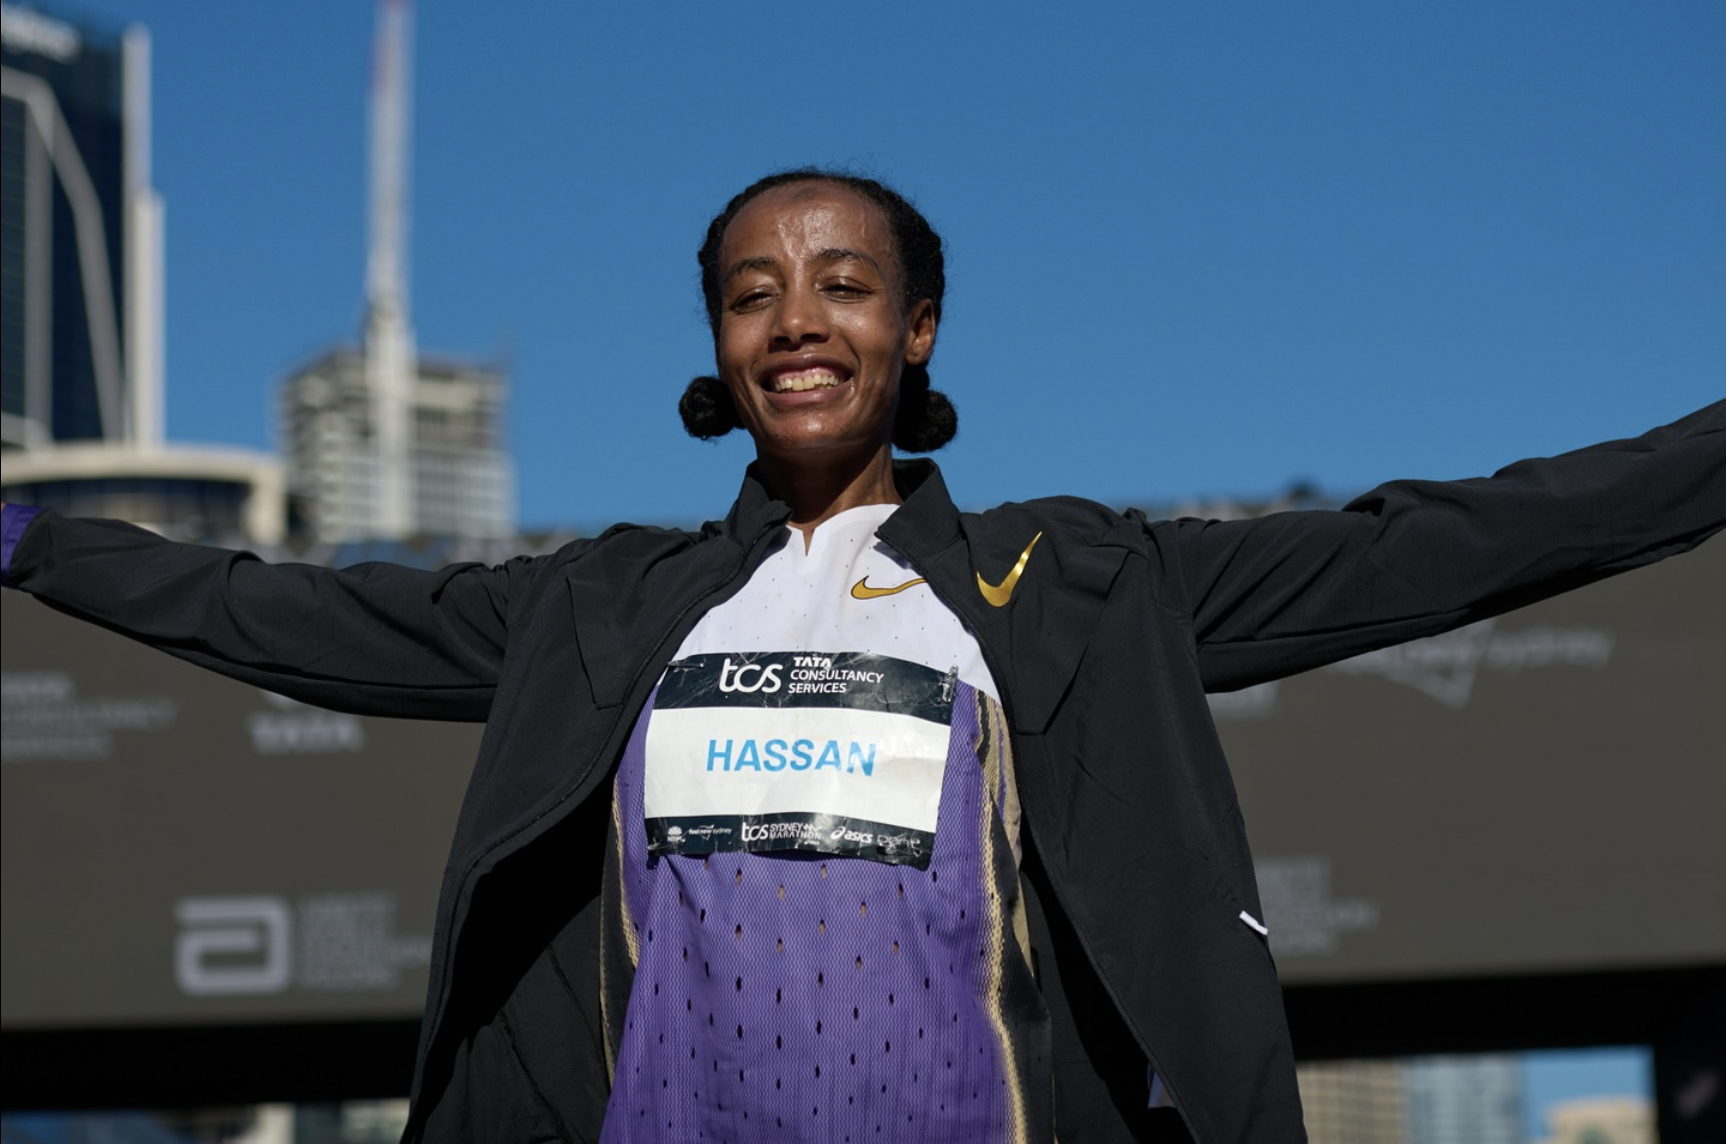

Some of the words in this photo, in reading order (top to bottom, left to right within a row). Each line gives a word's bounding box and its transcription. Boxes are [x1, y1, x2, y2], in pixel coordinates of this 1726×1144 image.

[793, 656, 833, 668] TATA
[719, 658, 783, 693] tcs
[790, 669, 884, 684] CONSULTANCY
[788, 682, 847, 694] SERVICES
[706, 738, 876, 777] HASSAN
[741, 821, 769, 842] tcs
[769, 822, 803, 833] SYDNEY
[769, 830, 821, 840] MARATHON
[844, 830, 873, 843] asics
